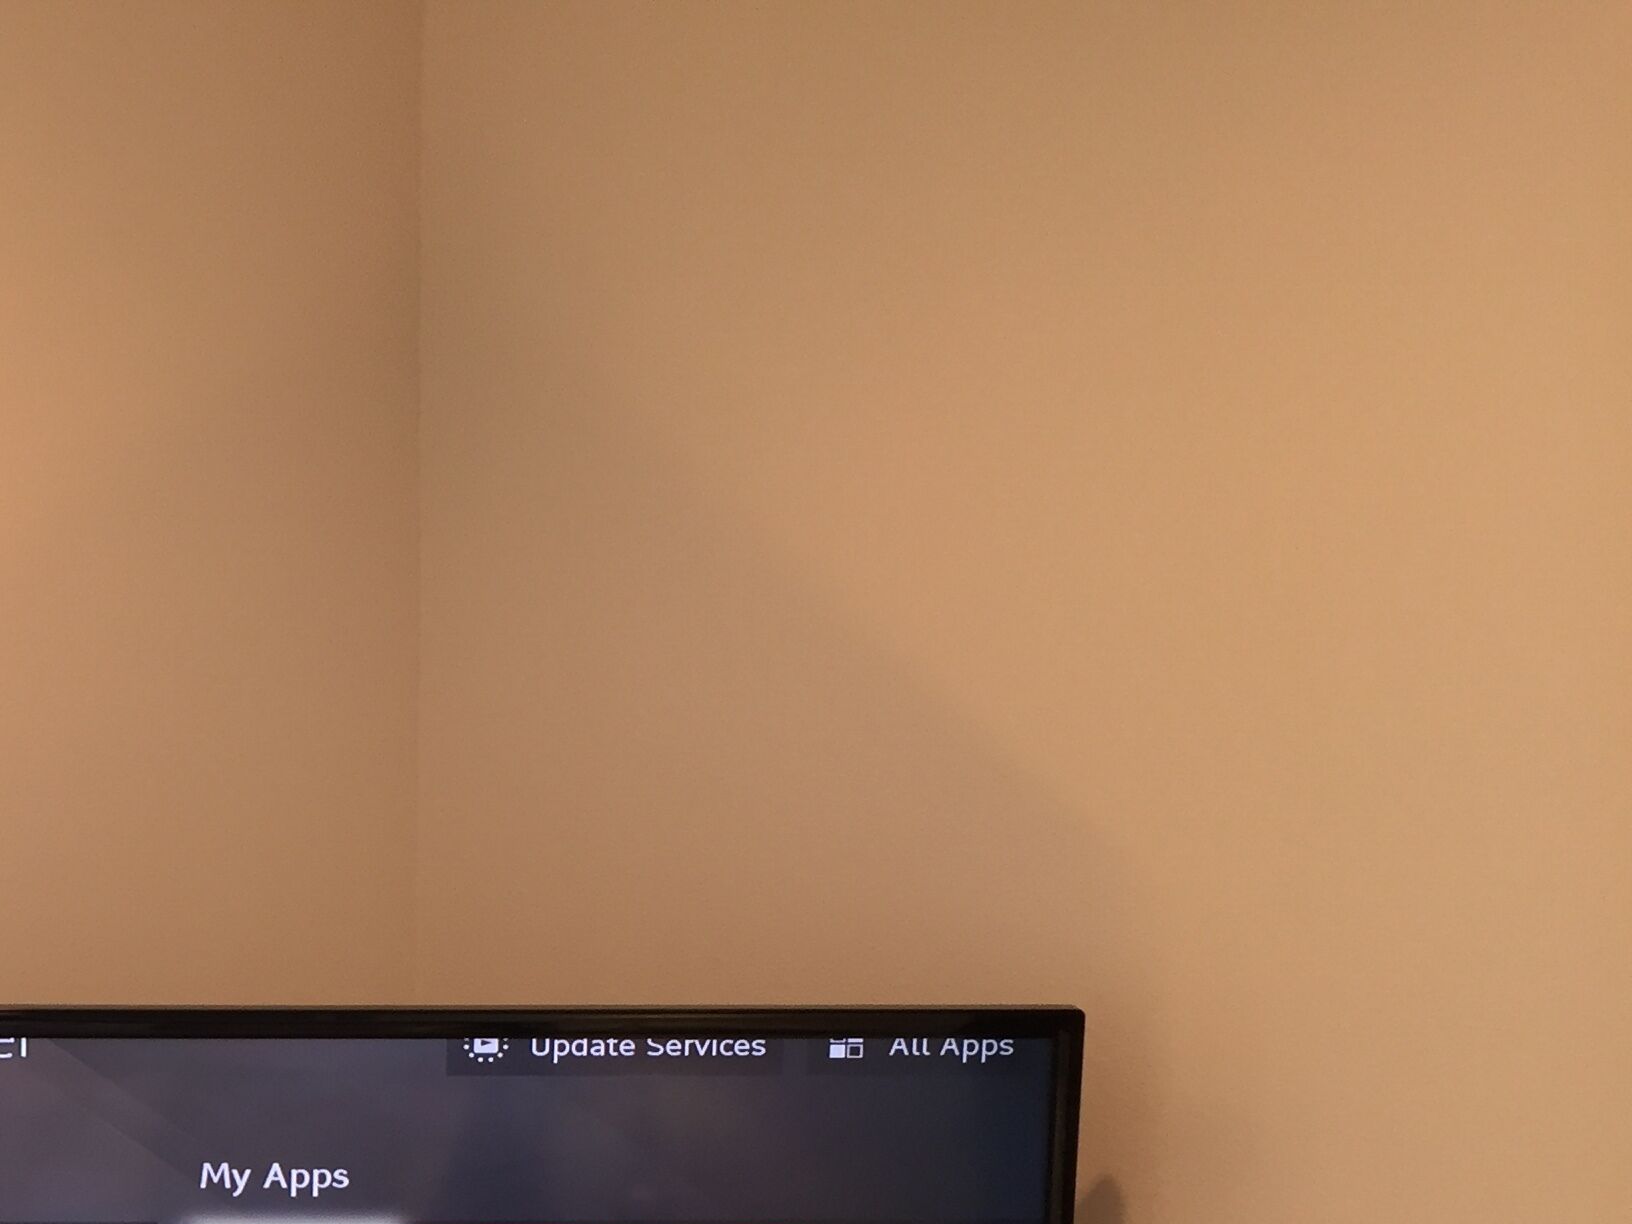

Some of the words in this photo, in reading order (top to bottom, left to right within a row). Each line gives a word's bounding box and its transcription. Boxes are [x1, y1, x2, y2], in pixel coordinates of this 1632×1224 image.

[531, 1038, 635, 1063] Update
[646, 1038, 766, 1057] Services
[889, 1038, 930, 1057] All
[940, 1038, 1014, 1064] Apps
[199, 1162, 252, 1197] My
[263, 1162, 350, 1197] Apps
